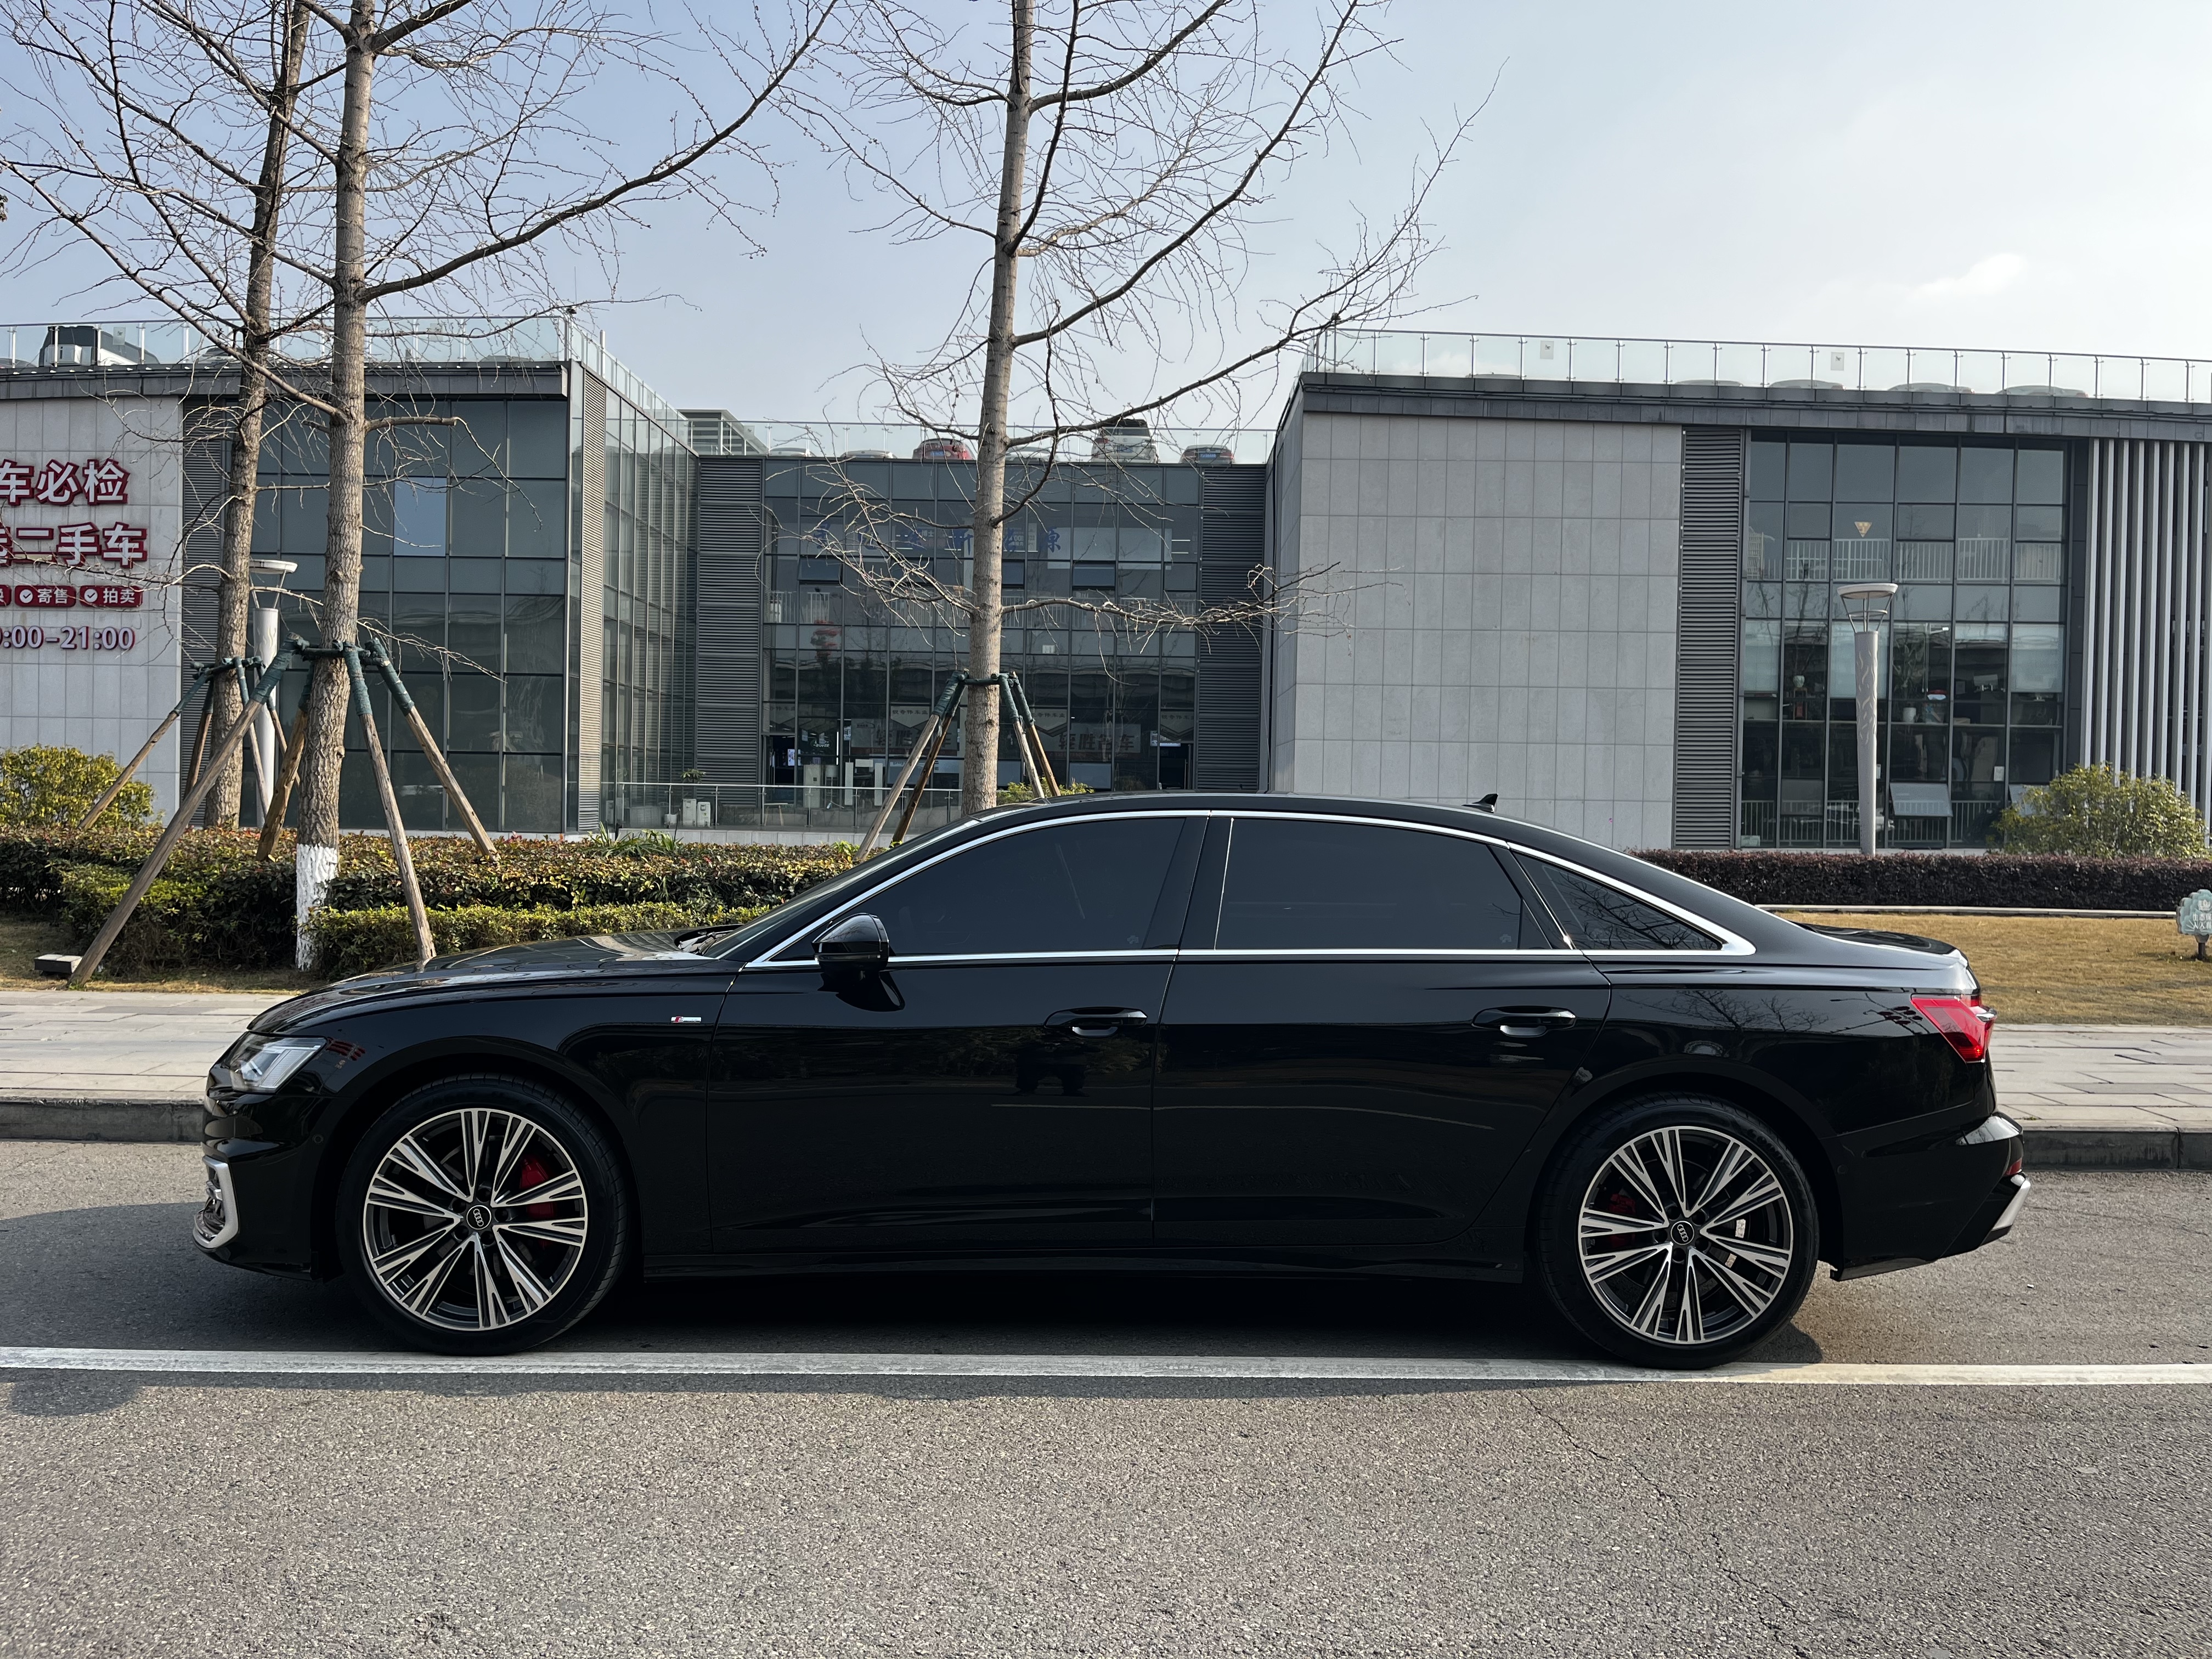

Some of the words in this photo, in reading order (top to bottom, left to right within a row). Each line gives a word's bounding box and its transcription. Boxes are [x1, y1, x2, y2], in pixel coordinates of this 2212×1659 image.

[0, 459, 129, 505] 车必检
[37, 588, 68, 604] 寄售
[103, 588, 136, 604] 拍卖
[0, 625, 135, 651] :00-21:00
